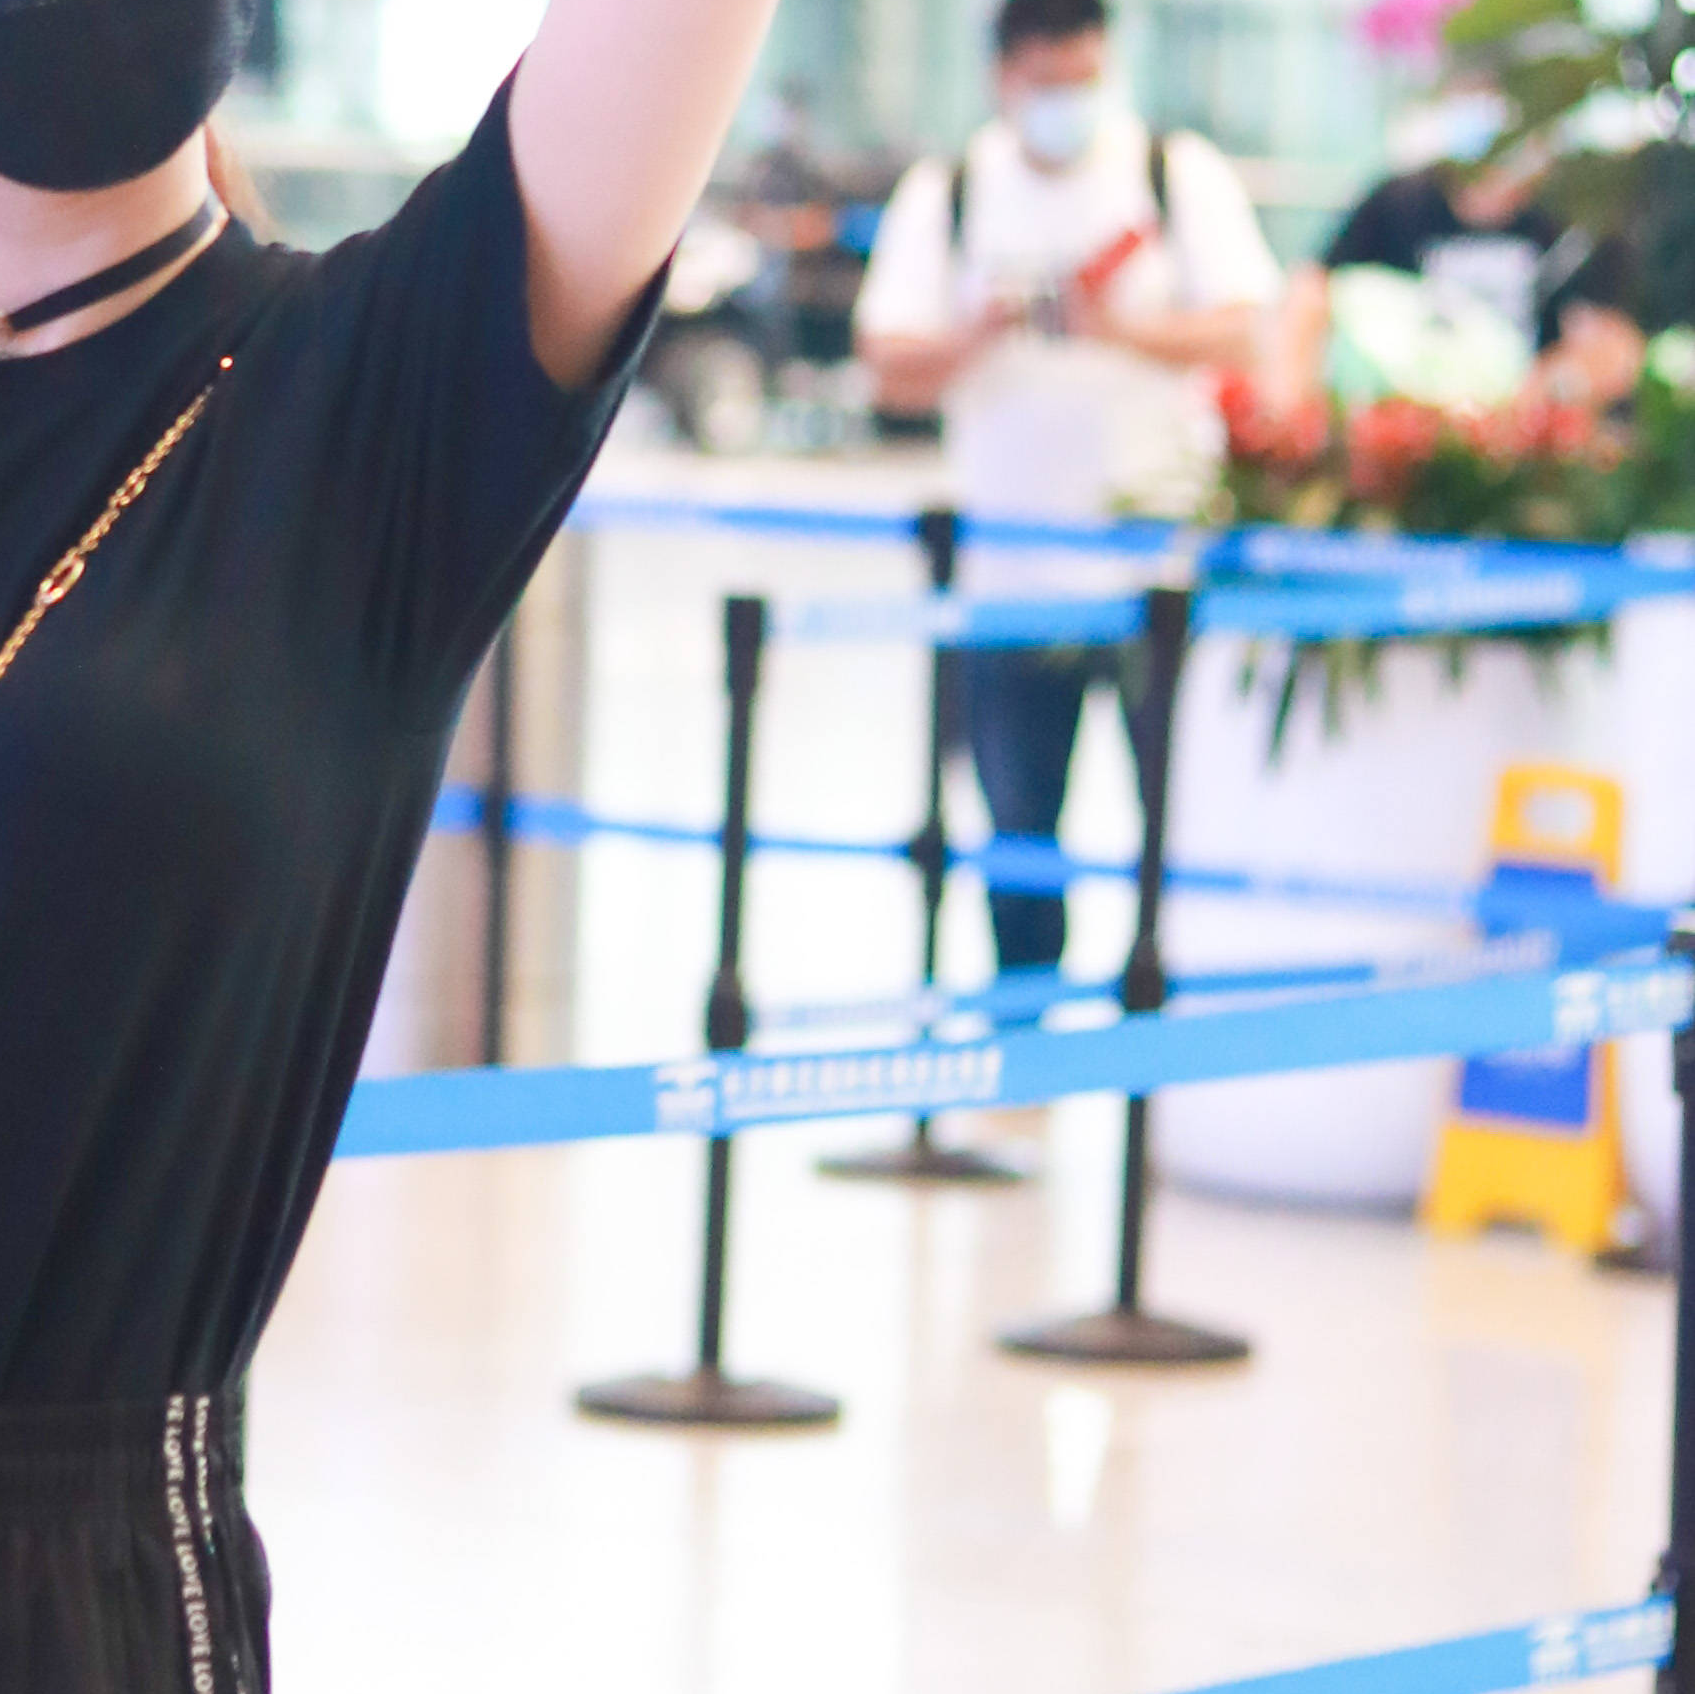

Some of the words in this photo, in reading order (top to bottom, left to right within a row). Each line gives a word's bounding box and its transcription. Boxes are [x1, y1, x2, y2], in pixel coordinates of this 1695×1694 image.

[163, 1425, 184, 1482] LOVE
[166, 1485, 192, 1538] LOVE
[175, 1543, 204, 1599] LOVE
[186, 1602, 212, 1657] LOVE
